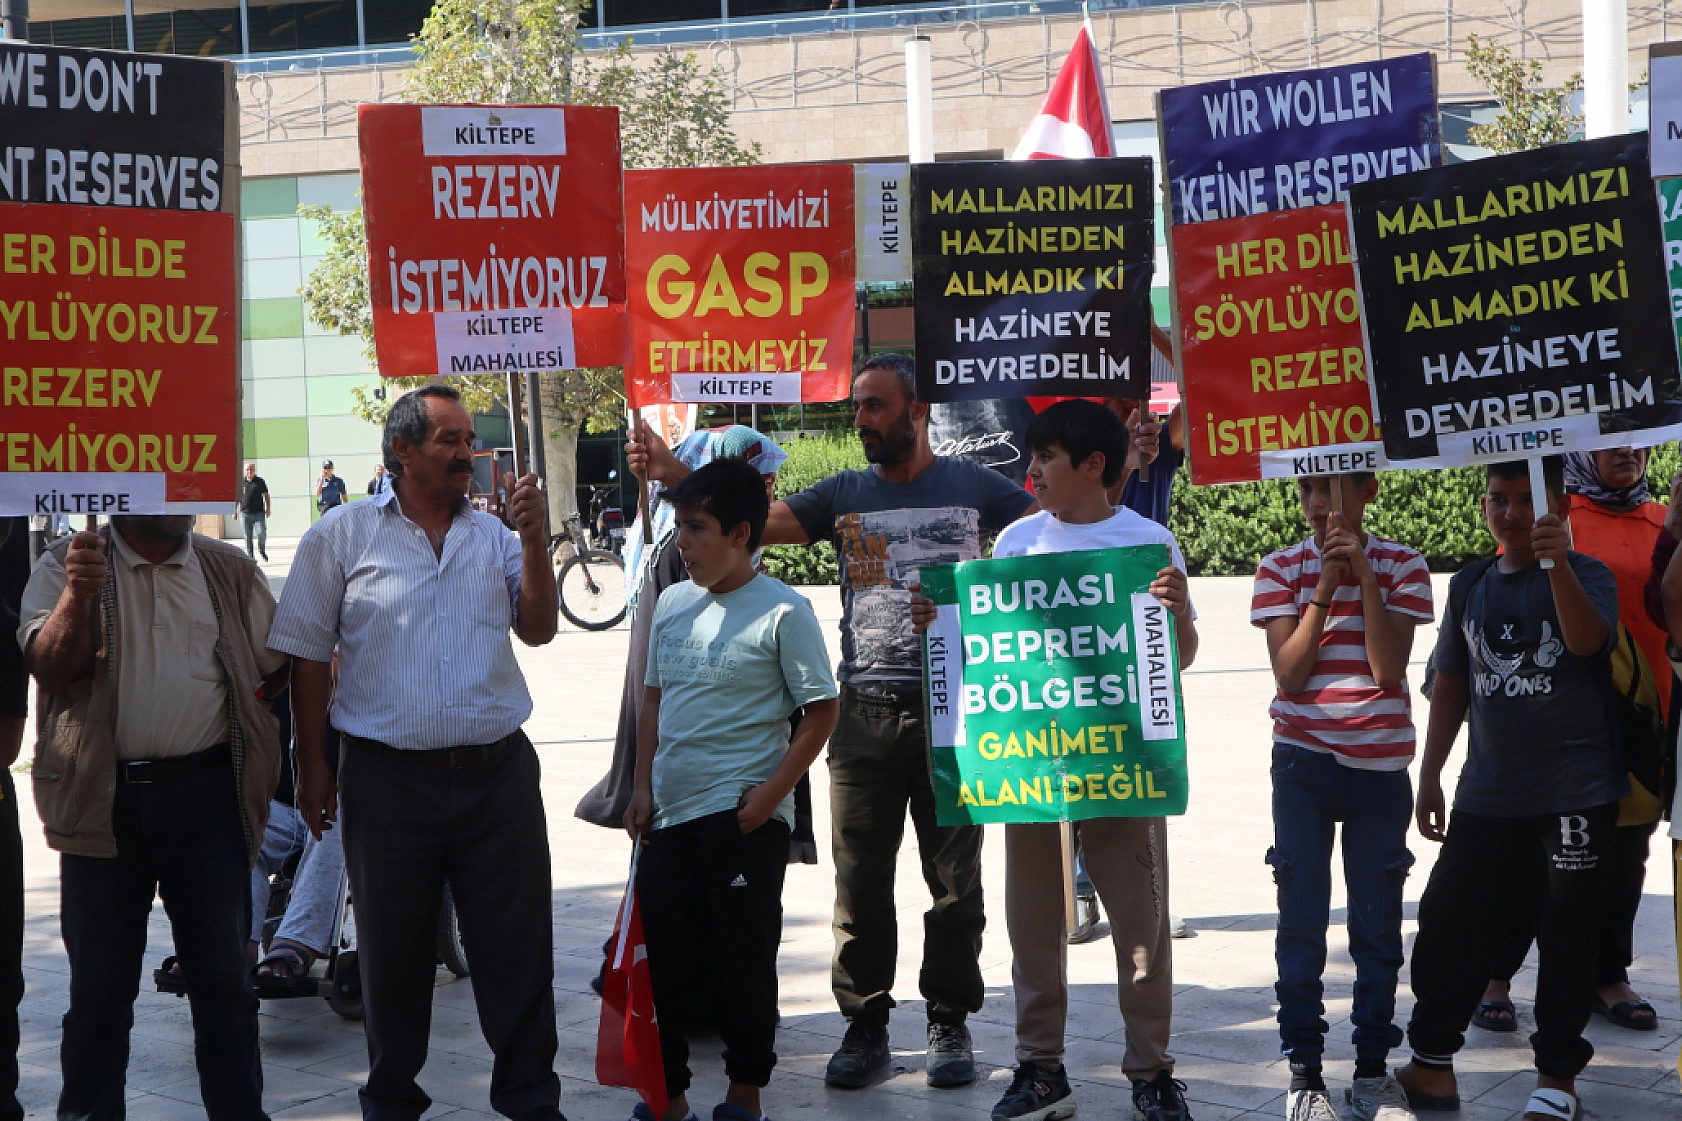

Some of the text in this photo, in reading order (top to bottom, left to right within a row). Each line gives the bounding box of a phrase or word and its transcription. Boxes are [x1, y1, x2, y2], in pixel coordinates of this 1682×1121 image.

[1202, 68, 1394, 140] WİR WOLLEN
[455, 122, 536, 145] KİLTEPE
[46, 149, 219, 212] RESERVES
[431, 164, 561, 219] REZERV
[931, 183, 1134, 214] MALLARIMIZI
[1179, 159, 1269, 223] KEİNE
[1375, 166, 1630, 240] MALLARIMIZI
[641, 188, 830, 232] MÜLKİYETİMİZİ
[878, 179, 899, 254] KİLTEPE
[4, 227, 186, 279] ER DİLDE
[940, 221, 1125, 256] HAZİNEDEN
[1214, 236, 1289, 280] HER
[1393, 217, 1624, 285] HAZİNEDEN
[388, 242, 609, 314] İSTEMİYORUZ
[645, 251, 830, 319] GASP
[943, 259, 1124, 297] ALMADIK Kİ
[1404, 275, 1582, 333] ALMADIK
[1589, 259, 1630, 304] Kİ
[0, 291, 218, 344] YLÜYORUZ
[466, 313, 544, 336] KİLTEPE
[954, 306, 1112, 343] HAZİNEYE
[1193, 284, 1360, 341] SÖYLÜYO
[450, 345, 563, 373] MAHALLESİ
[649, 329, 828, 374] ETTİRMEYİZ
[934, 347, 1131, 386] DEVREDELİM
[1249, 346, 1367, 394] REZER
[1421, 327, 1623, 386] HAZİNEYE
[4, 367, 162, 408] REZERV
[699, 376, 772, 396] KİLTEPE
[1404, 371, 1656, 439] DEVREDELİM
[0, 422, 217, 472] EMİYORUZ
[1292, 450, 1377, 475] KİLTEPE
[1471, 427, 1565, 456] KİLTEPE
[35, 489, 130, 513] KİLTEPE
[969, 572, 1116, 616] BURASI
[964, 621, 1130, 667] DEPREM
[1143, 605, 1175, 728] MAHALLESİ
[928, 636, 949, 718] KİLTEPE
[965, 663, 1139, 716] BÖLGESİ
[1504, 672, 1552, 698] ONES
[977, 720, 1129, 761] GANİMET
[956, 763, 1168, 808] ALANI DEĞİL
